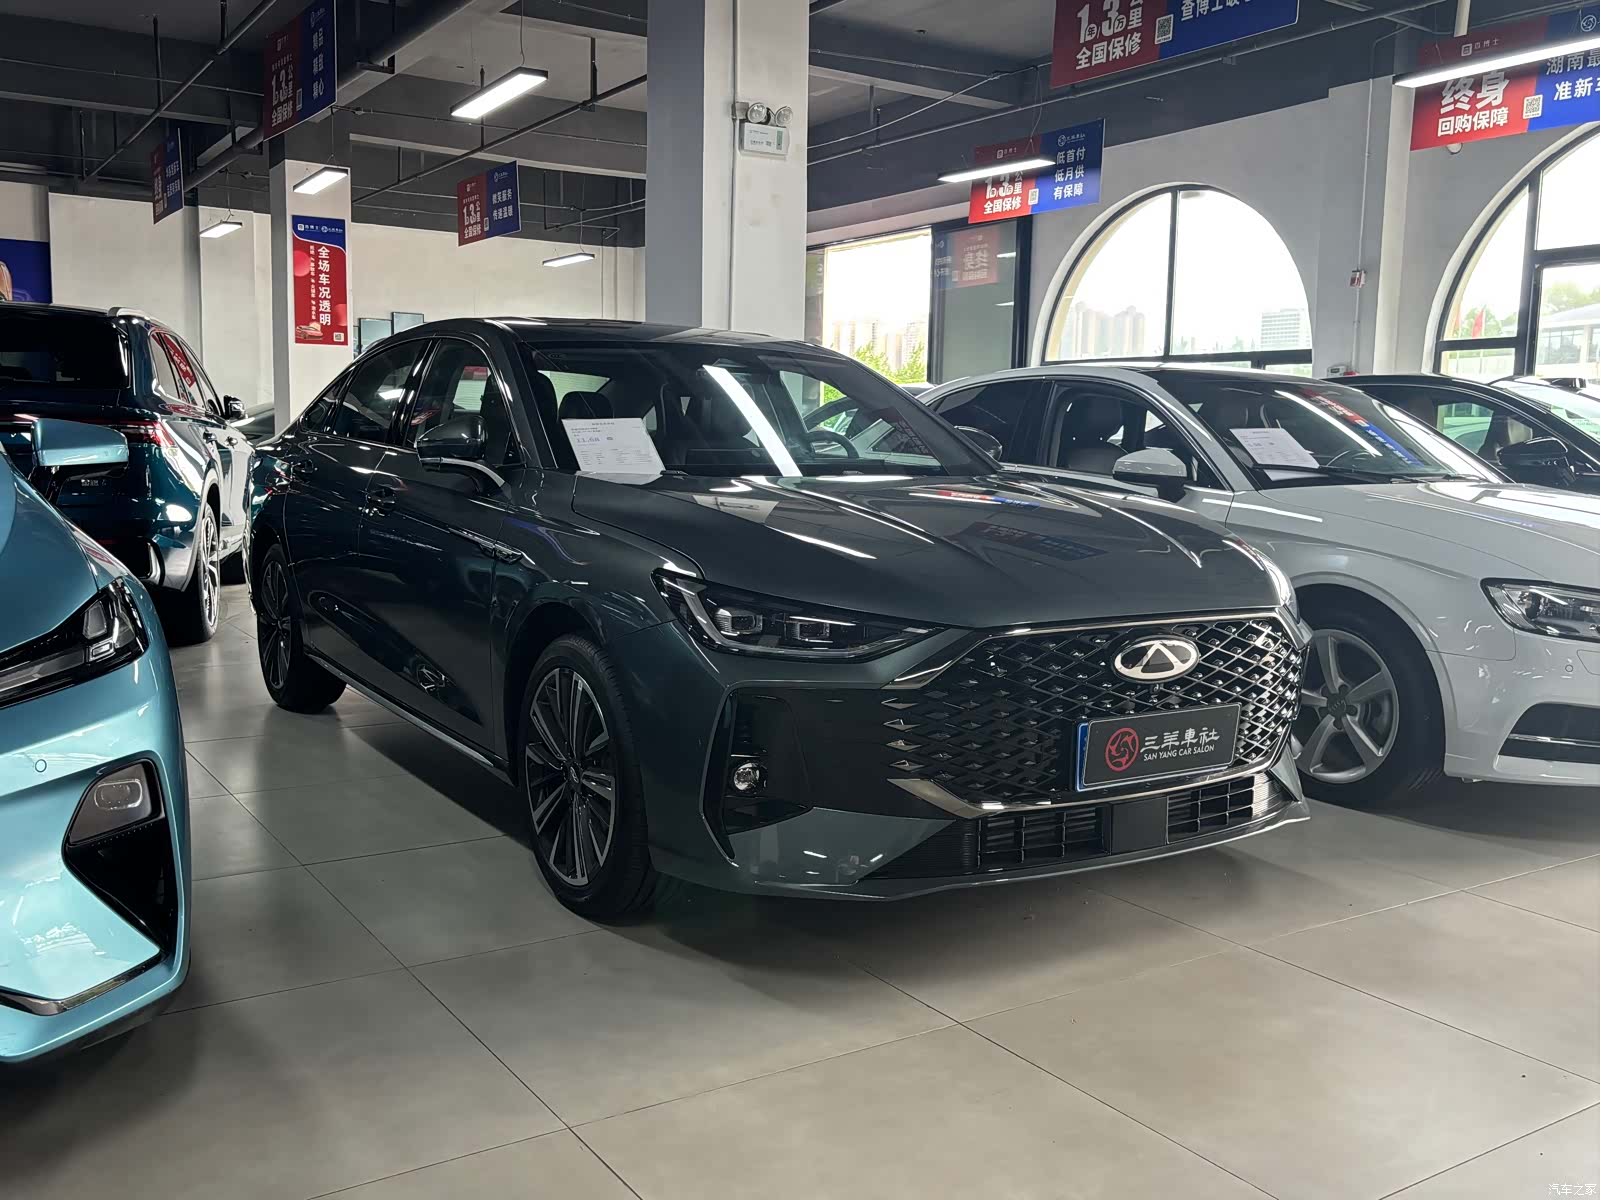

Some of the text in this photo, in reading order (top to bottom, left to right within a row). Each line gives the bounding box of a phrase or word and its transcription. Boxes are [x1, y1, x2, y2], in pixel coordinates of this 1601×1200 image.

[1181, 0, 1252, 21] 查博士
[1075, 31, 1142, 70] 全国保修
[1440, 70, 1510, 115] 终身
[1554, 76, 1600, 101] 准新
[271, 101, 293, 127] 全国保修
[1437, 107, 1509, 137] 回购保障
[1056, 148, 1086, 164] 低首付
[1054, 165, 1085, 183] 低月供
[1053, 183, 1084, 201] 有保障
[983, 195, 1022, 215] 全国保修
[464, 224, 481, 238] 全国保修
[318, 246, 331, 326] 全场车况透明
[1143, 744, 1215, 761] SAN YANG CAR SALON
